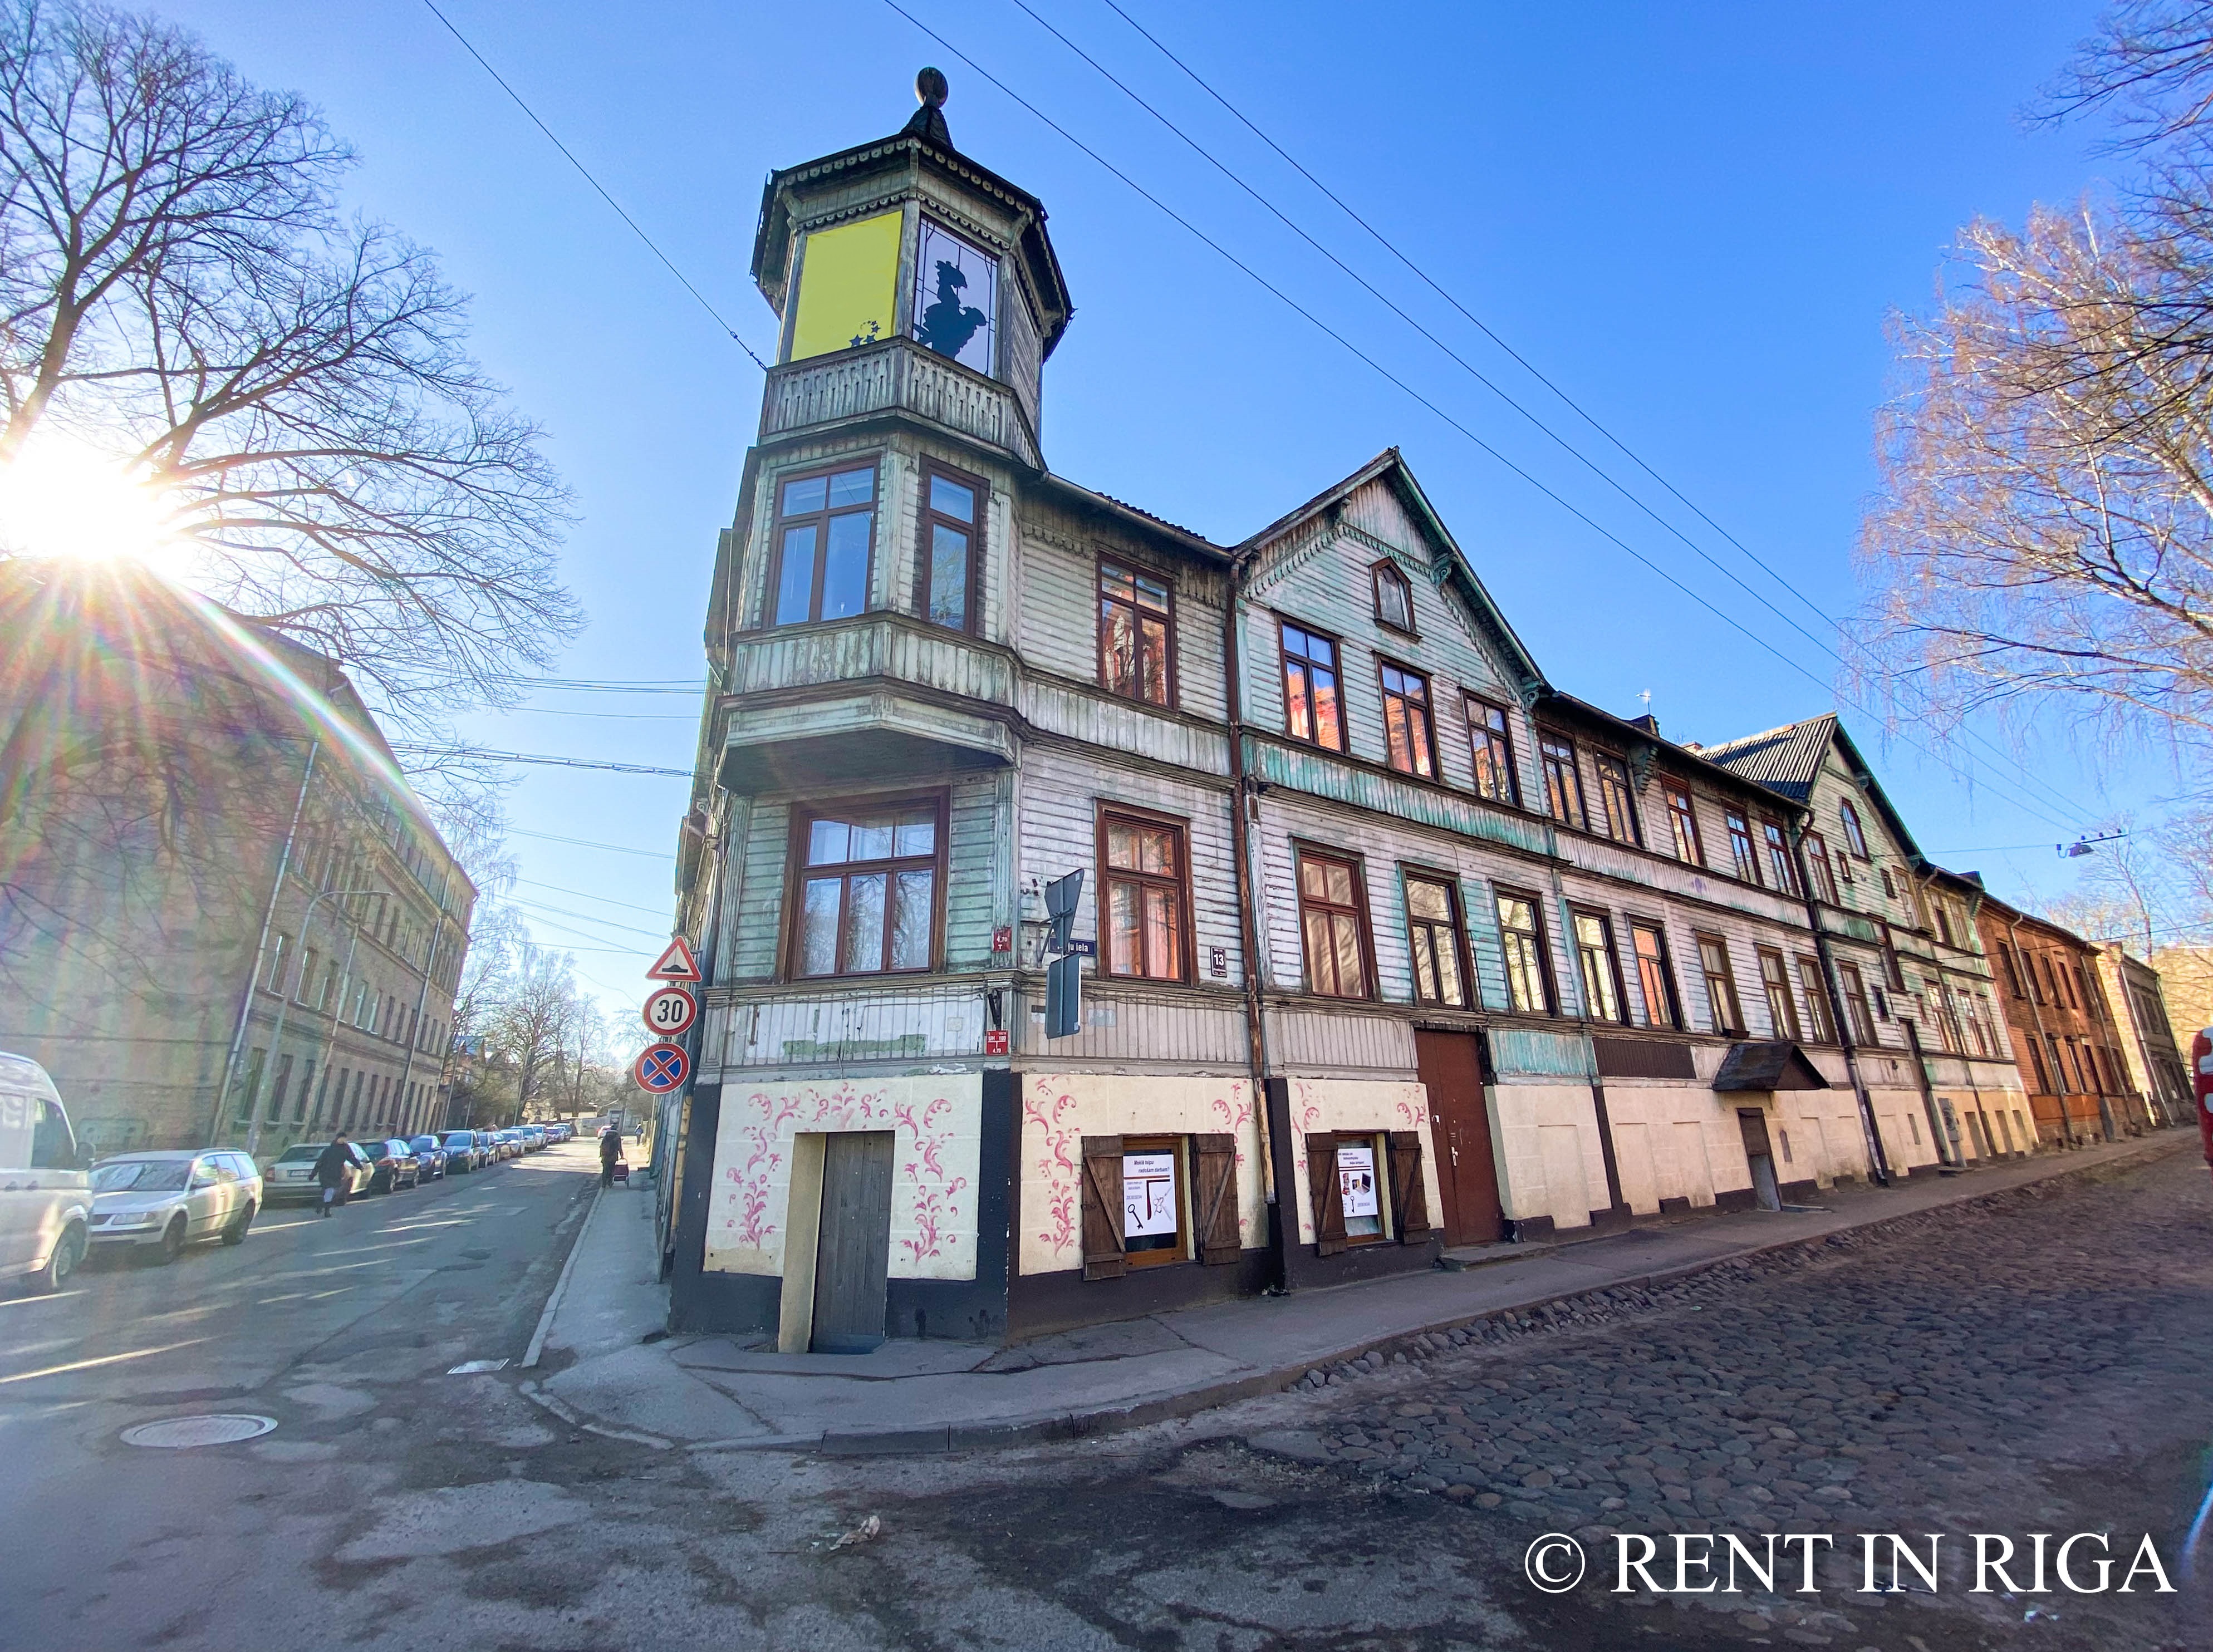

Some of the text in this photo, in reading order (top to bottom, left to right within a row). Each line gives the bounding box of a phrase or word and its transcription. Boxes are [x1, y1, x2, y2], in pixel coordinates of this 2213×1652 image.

[1076, 942, 1088, 952] iela
[1214, 953, 1224, 966] 13
[657, 1000, 683, 1022] 30
